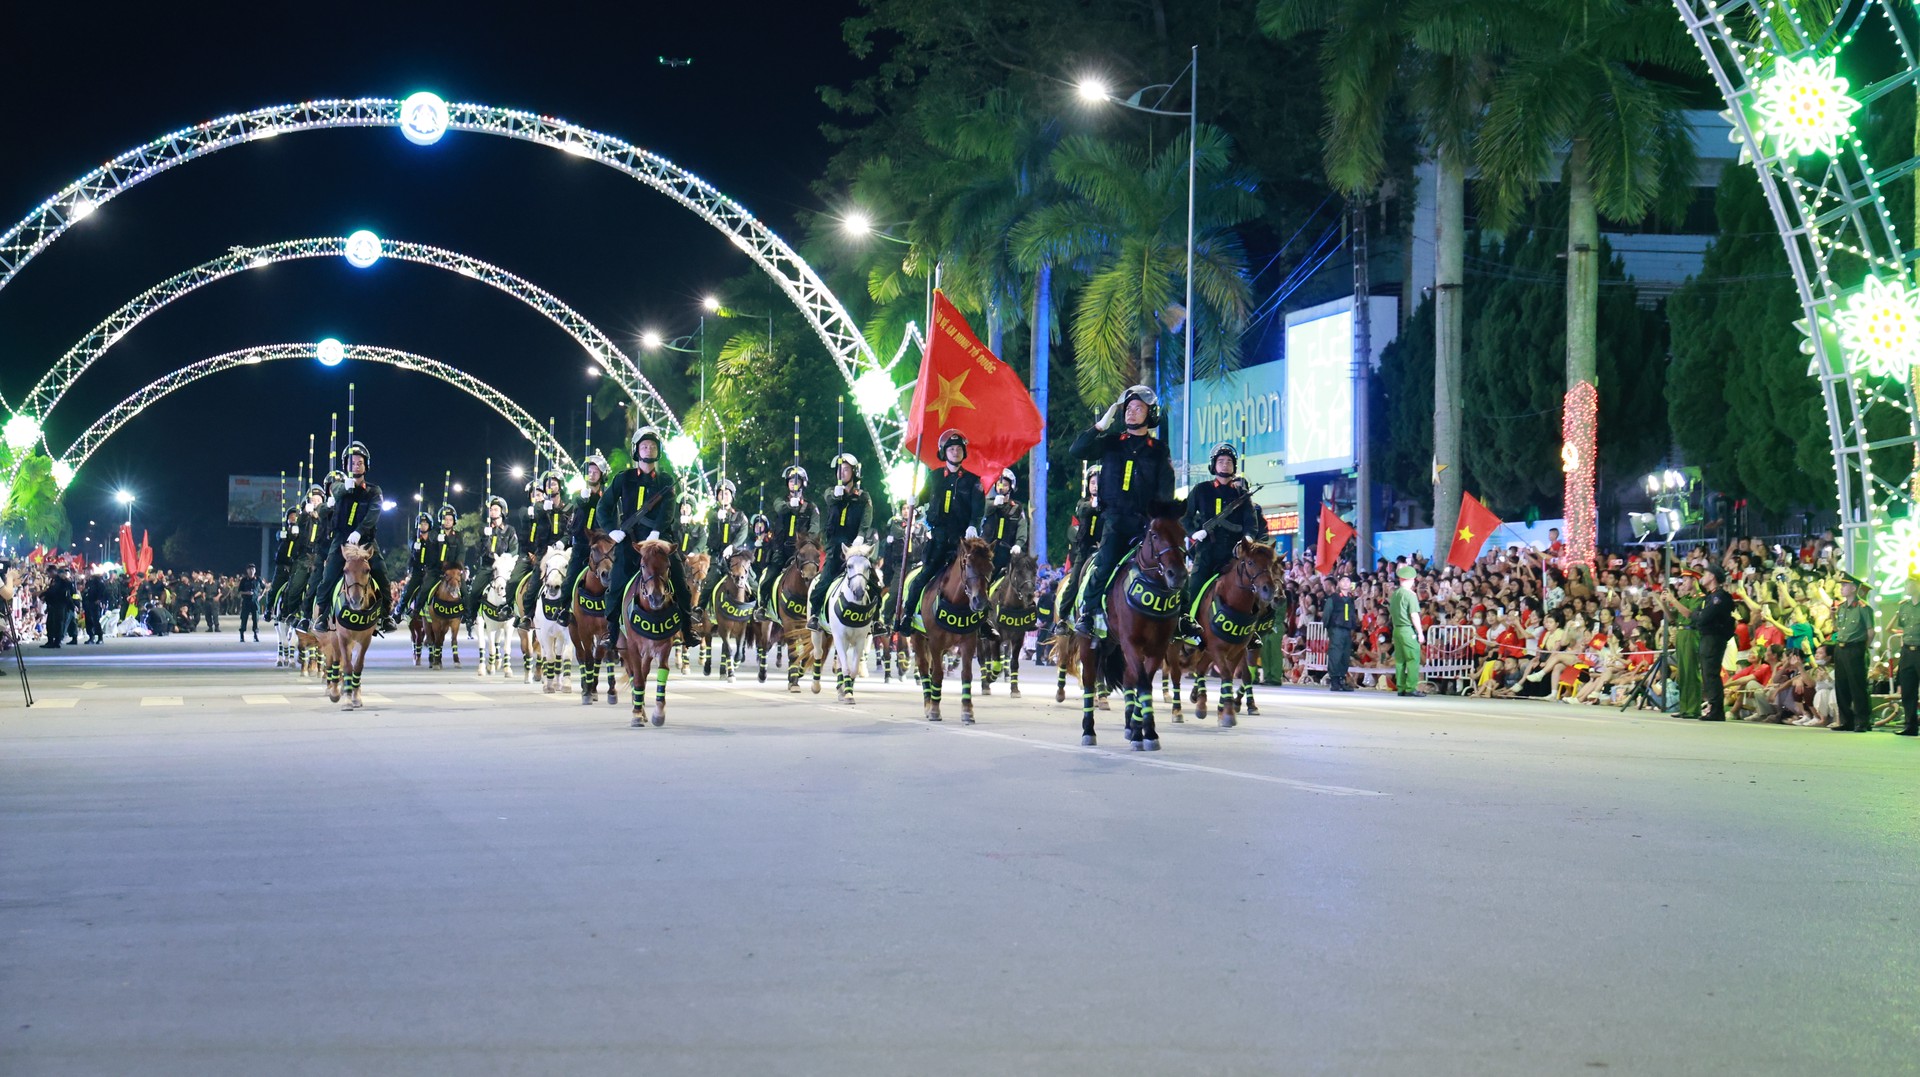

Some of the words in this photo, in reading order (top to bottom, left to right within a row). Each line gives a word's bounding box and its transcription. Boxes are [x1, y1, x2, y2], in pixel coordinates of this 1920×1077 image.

[953, 332, 972, 350] NINH
[1196, 383, 1285, 448] vinaphon
[579, 596, 606, 610] POLI
[1131, 583, 1181, 612] POLICE
[341, 606, 381, 625] POLICE
[433, 602, 464, 615] POLICE
[482, 604, 498, 617] POL
[721, 601, 753, 617] POLICE
[787, 600, 807, 615] POL
[633, 612, 680, 634] POLICE
[938, 609, 985, 627] POLICE
[999, 612, 1037, 627] POLICE
